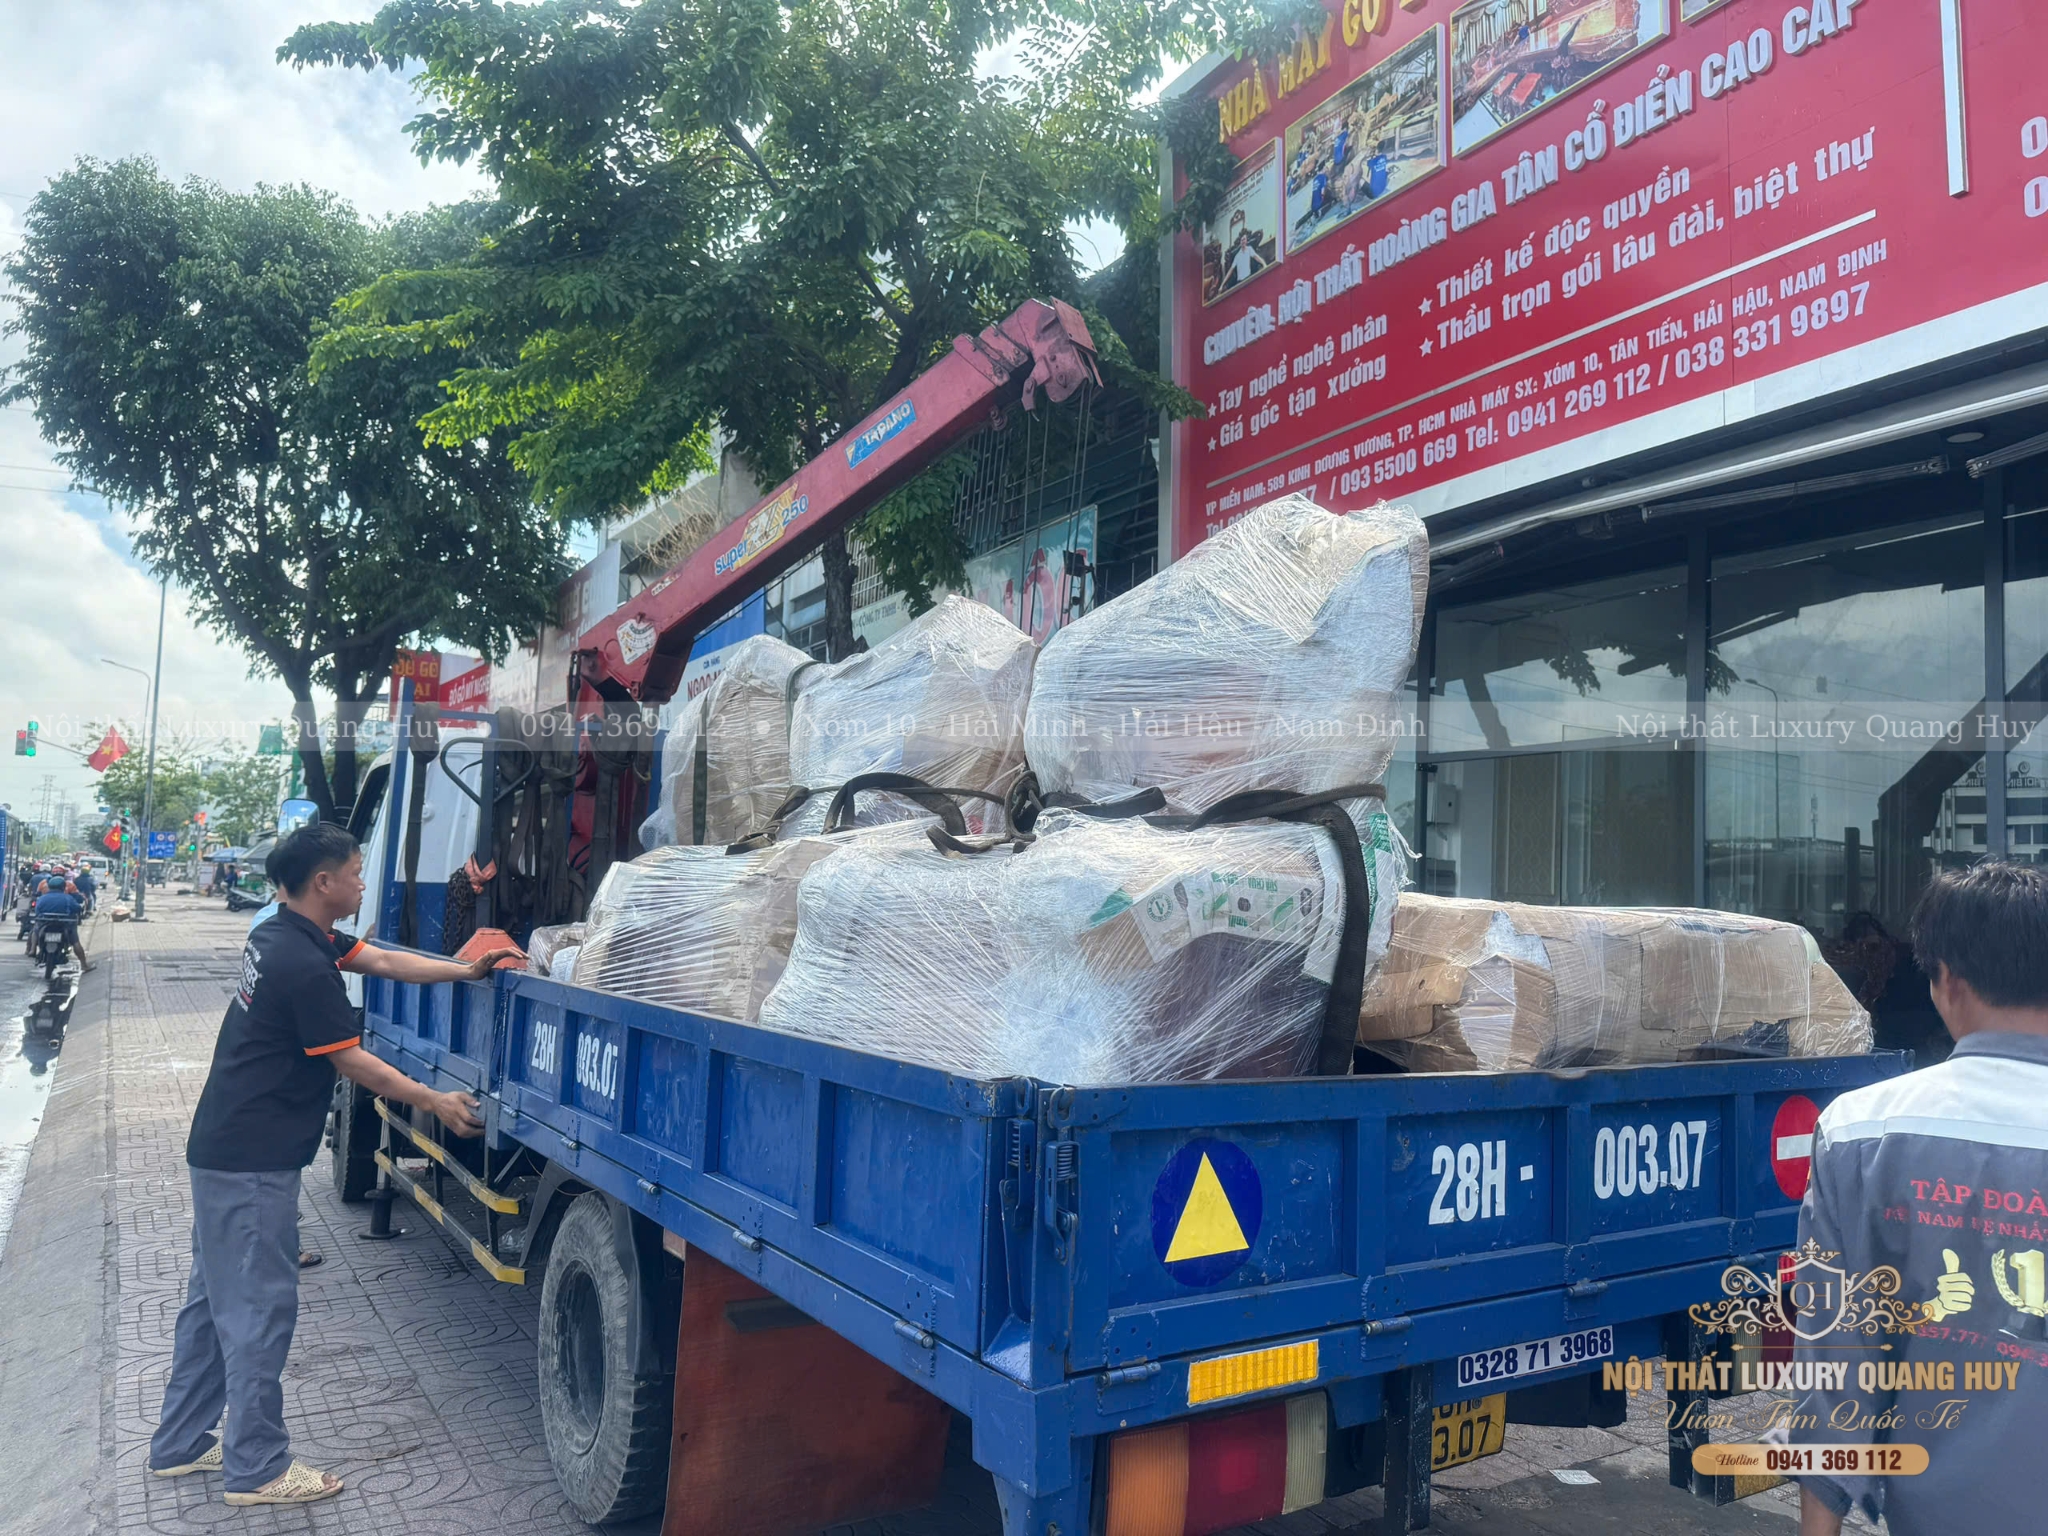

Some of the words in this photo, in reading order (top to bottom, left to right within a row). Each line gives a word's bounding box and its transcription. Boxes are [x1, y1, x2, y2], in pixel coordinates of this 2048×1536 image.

[1278, 278, 1311, 326] NỘI
[1315, 244, 1364, 305] THẤT
[1368, 207, 1447, 276] HOÀNG
[1451, 180, 1496, 233] GIA
[1501, 143, 1558, 206] TÂN
[1564, 99, 1608, 172] CỔ
[1613, 64, 1692, 147] ĐIỂN
[1700, 28, 1772, 98] CAO
[1437, 256, 1493, 307] Thiết
[1504, 232, 1535, 277] kế
[1545, 210, 1591, 259] độc
[1603, 165, 1691, 230] quyền
[1437, 303, 1491, 349] Thầu
[1502, 280, 1550, 319] trọn
[1562, 251, 1601, 300] gói
[1613, 229, 1656, 274] lâu
[1668, 199, 1723, 248] đài,
[1734, 161, 1799, 218] biệt
[1814, 126, 1876, 181] thự
[1205, 501, 1217, 516] VP
[1267, 474, 1285, 493] 589
[1288, 463, 1311, 486] KINH
[1397, 423, 1415, 445] TP.
[1419, 411, 1445, 437] HCM
[1450, 397, 1477, 422] NHÀ
[1481, 385, 1510, 412] MÁY
[1515, 376, 1539, 400] SX:
[1543, 359, 1576, 387] XÓM
[1609, 334, 1639, 365] TÂN
[1693, 299, 1723, 332] HẢI
[1779, 263, 1827, 298] NAM
[1837, 239, 1887, 277] ĐỊNH
[1218, 384, 1243, 413] Tay
[1250, 353, 1288, 404] nghề
[1293, 335, 1335, 378] nghệ
[1341, 314, 1387, 353] nhân
[1219, 415, 1244, 448] Giá
[1250, 400, 1280, 437] gốc
[1288, 386, 1317, 418] tận
[1327, 354, 1387, 398] xưởng
[1340, 465, 1371, 496] 093
[1374, 448, 1417, 486] 5500
[1423, 434, 1457, 467] 669
[1466, 418, 1500, 452] Tel:
[1507, 403, 1556, 438] 0941
[1564, 380, 1607, 419] 269
[1613, 364, 1651, 400] 112
[1675, 337, 1725, 380] 038
[1732, 317, 1782, 357] 331
[1790, 280, 1871, 336] 9897
[715, 540, 748, 575] super
[781, 494, 809, 527] 250
[531, 1021, 557, 1075] 28H
[1428, 1139, 1507, 1225] 28H
[1594, 1120, 1707, 1199] 003.07
[1910, 1177, 1972, 1208] TẬP
[1917, 1210, 1964, 1228] NAM
[1460, 1347, 1519, 1384] 0328
[1525, 1341, 1550, 1371] 71
[1560, 1328, 1612, 1362] 3968
